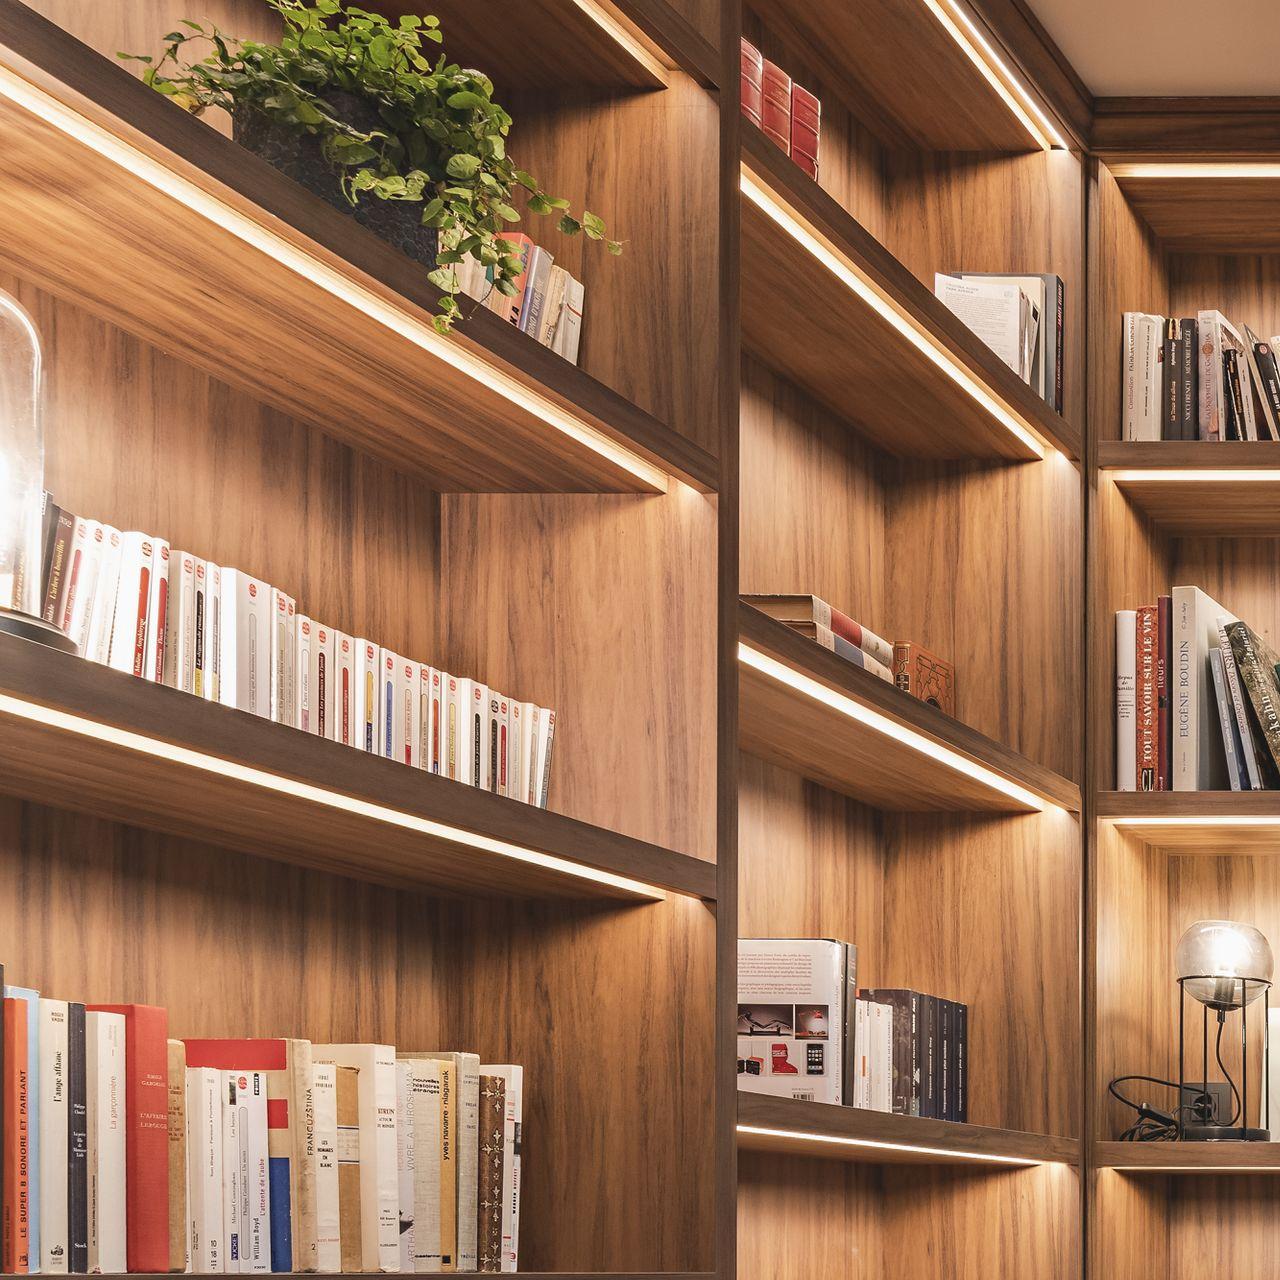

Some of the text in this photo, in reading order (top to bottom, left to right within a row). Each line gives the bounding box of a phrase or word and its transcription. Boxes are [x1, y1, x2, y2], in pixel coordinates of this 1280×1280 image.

[1143, 612, 1152, 762] TOUT SAVOIR SUR LE VIN
[1179, 640, 1190, 738] EUGÈNE BOUDIN
[1230, 671, 1240, 690] Décors
[1233, 703, 1246, 734] Créations
[108, 1076, 118, 1129] La garçonnière
[441, 1070, 450, 1105] niagarak
[20, 1120, 26, 1130] ET
[442, 1142, 450, 1161] yves
[258, 1159, 266, 1216] L'attente de l'aube
[20, 1227, 26, 1238] LE
[253, 1217, 261, 1233] Boyd
